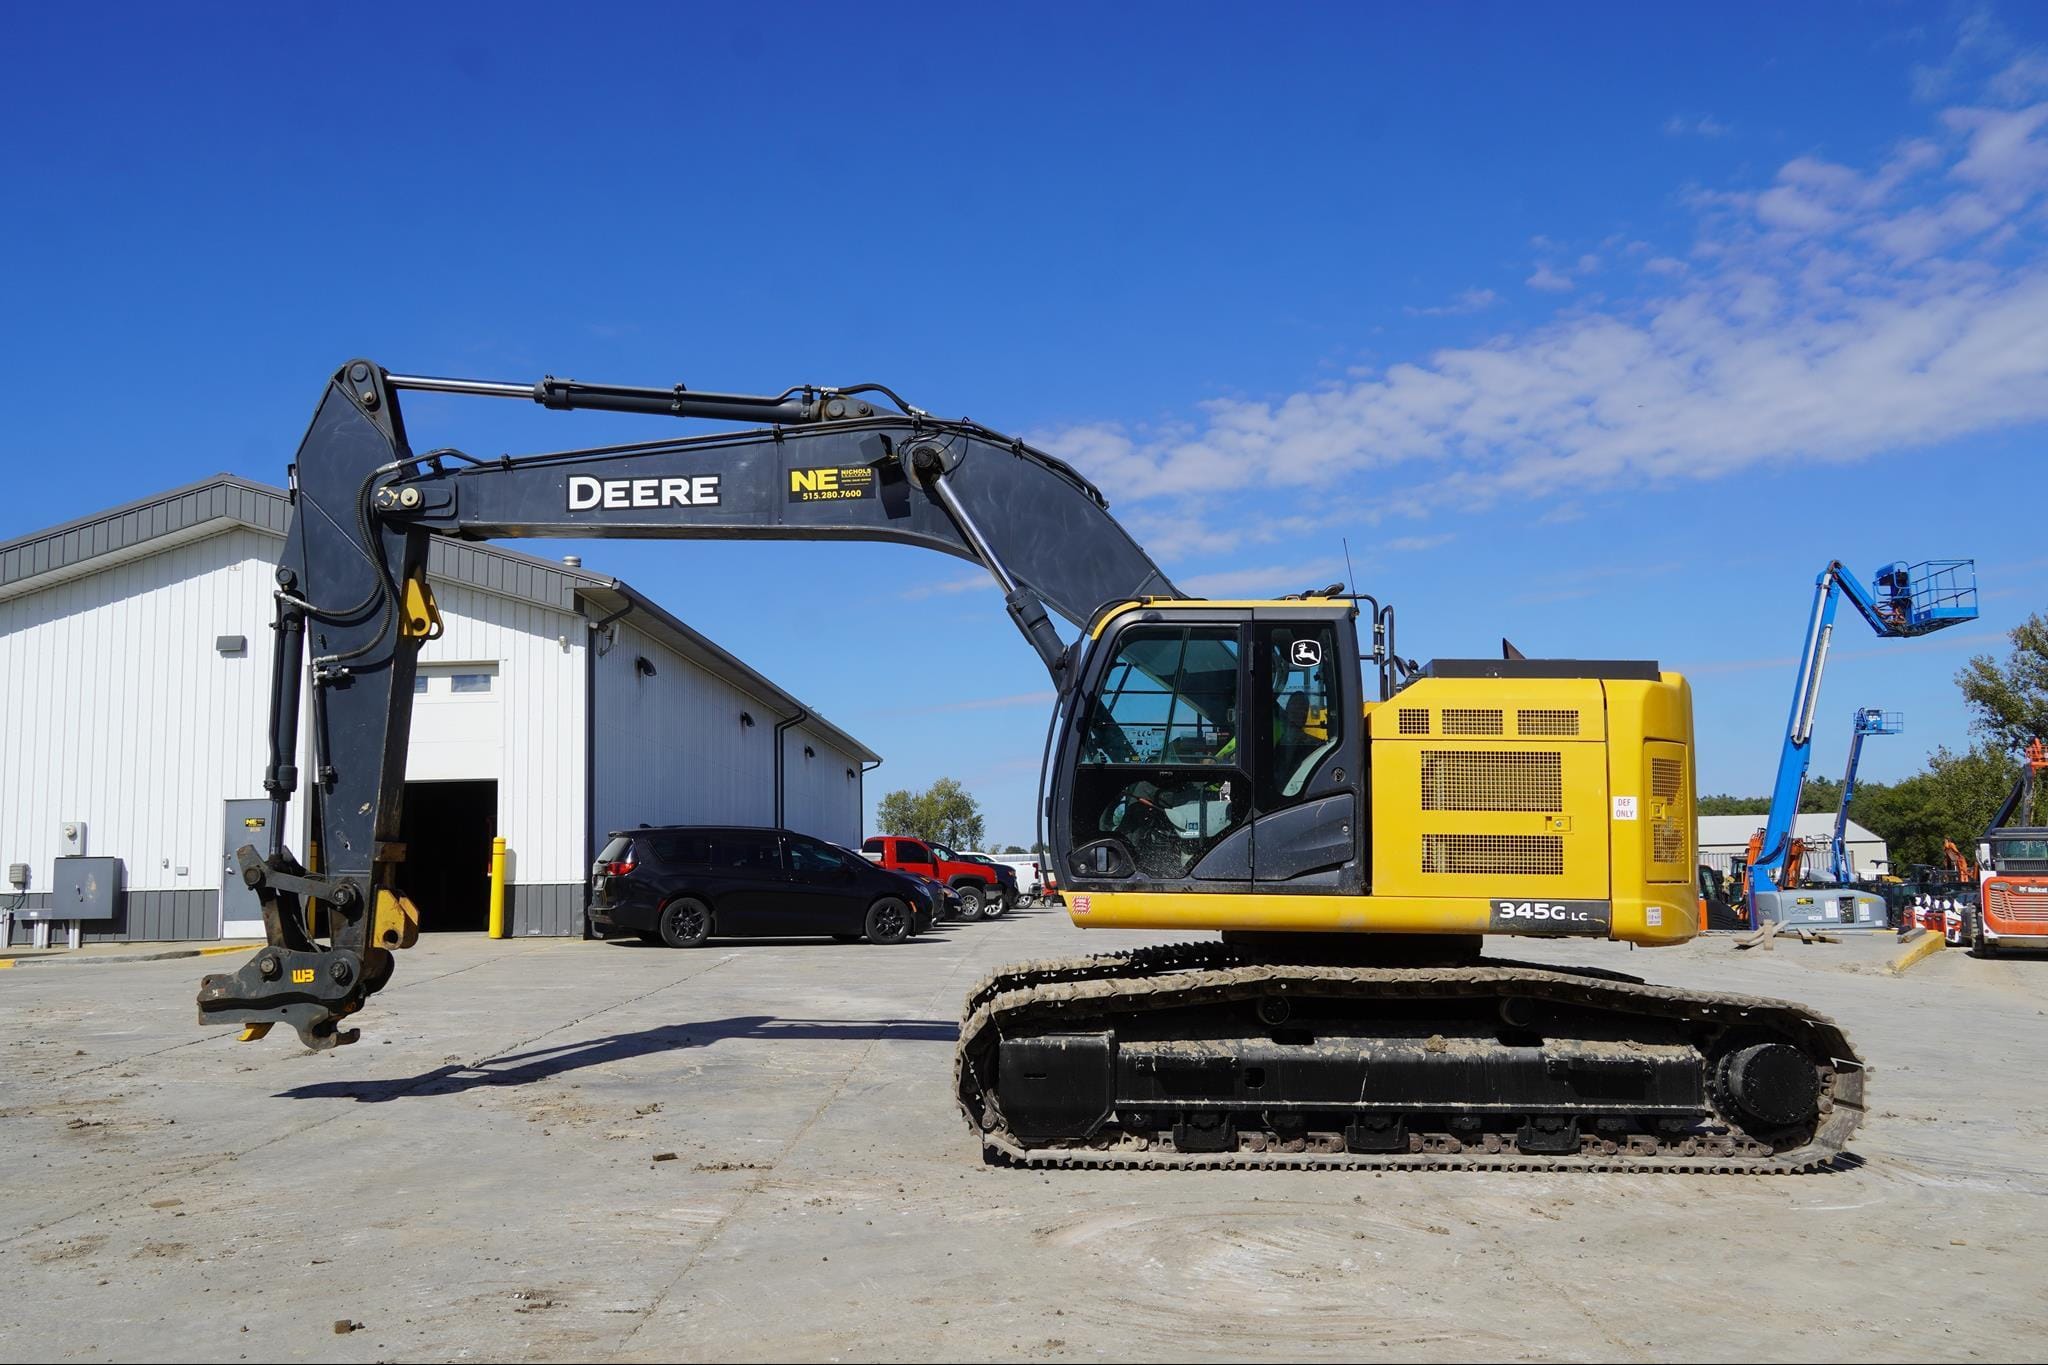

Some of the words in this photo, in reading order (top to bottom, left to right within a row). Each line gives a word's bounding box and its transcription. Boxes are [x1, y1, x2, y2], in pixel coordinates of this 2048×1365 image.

[791, 468, 838, 492] NE
[568, 475, 719, 510] DEERE
[802, 489, 862, 500] 515.280.7600
[1617, 798, 1632, 807] DEF
[1615, 809, 1634, 818] ONLY
[1499, 902, 1566, 920] 345G
[1571, 912, 1588, 921] LC
